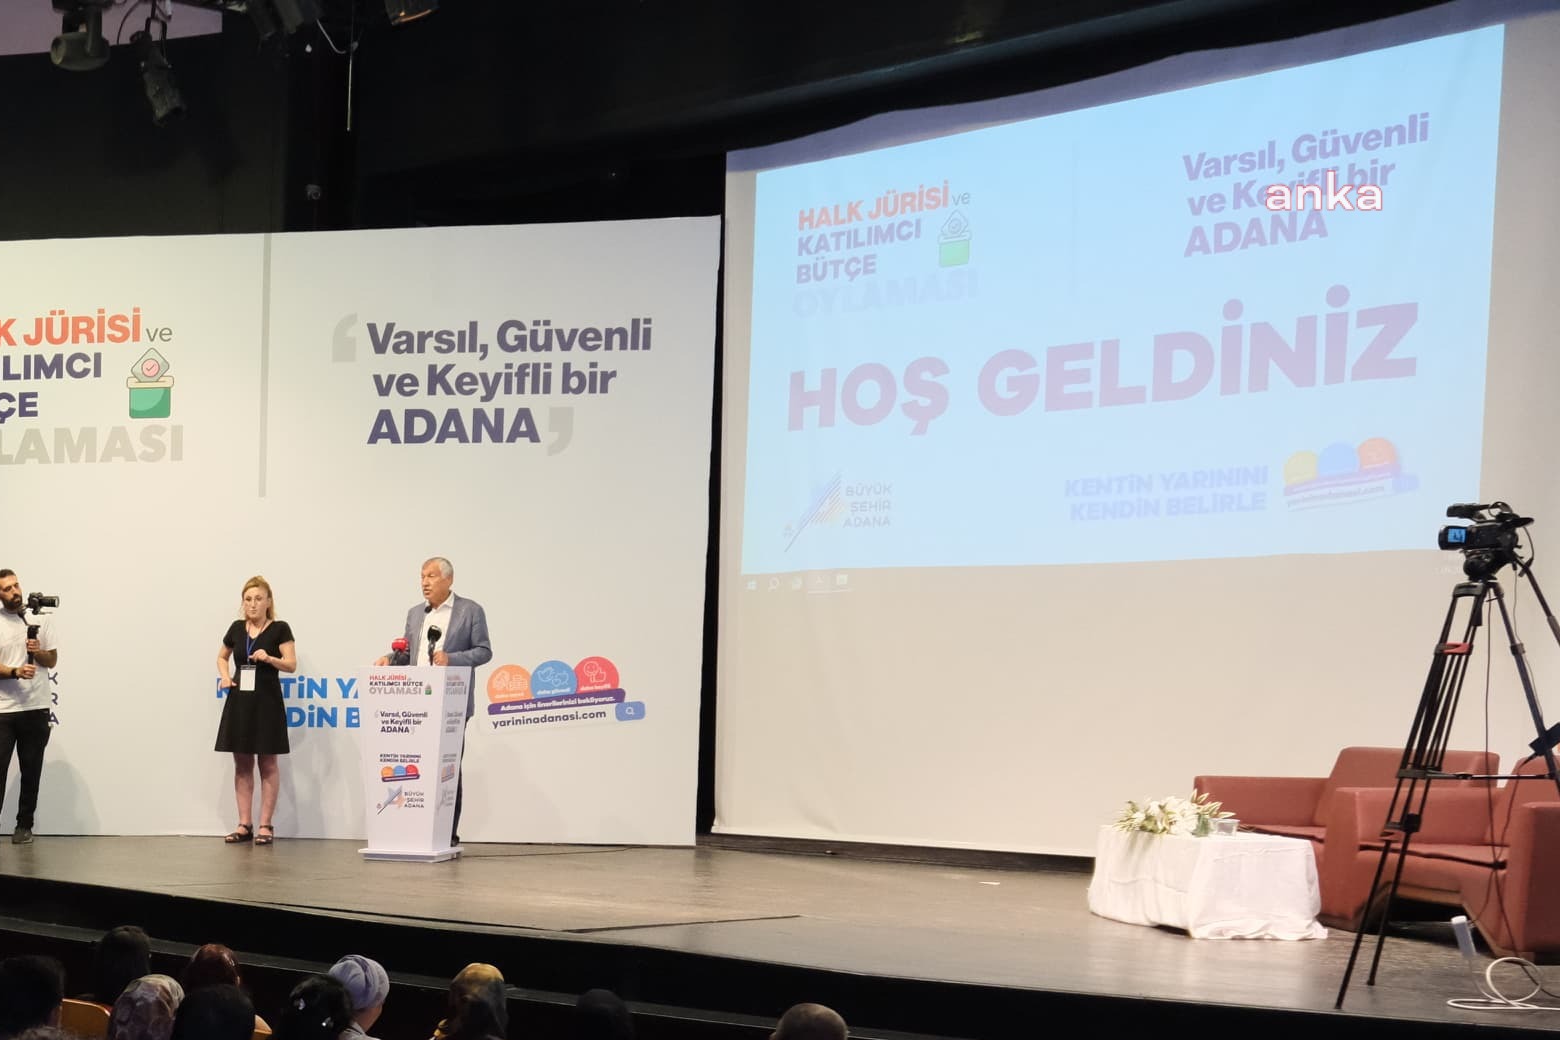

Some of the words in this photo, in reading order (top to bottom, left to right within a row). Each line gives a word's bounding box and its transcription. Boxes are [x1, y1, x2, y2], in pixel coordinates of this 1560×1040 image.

[1292, 112, 1430, 164] Güvenli
[798, 200, 864, 231] HALK
[867, 180, 950, 220] JÜRİSİ
[951, 192, 971, 206] ve
[1187, 193, 1226, 216] ve
[797, 218, 922, 256] KATILIMCI
[1183, 208, 1329, 258] ADANA
[796, 254, 878, 284] BÜTÇE
[24, 307, 141, 347] JÜRİSİ
[146, 326, 173, 342] ve
[367, 321, 488, 361] Varsıl,
[496, 318, 652, 353] Güvenli
[787, 356, 951, 436] HOŞ
[977, 284, 1420, 417] GELDİNİZ
[372, 373, 419, 397] ve
[427, 362, 552, 402] Keyifli
[561, 362, 617, 394] bir
[367, 407, 541, 444] ADANA
[369, 687, 422, 695] OYLAMASI
[492, 710, 607, 729] yarininadanasi.com
